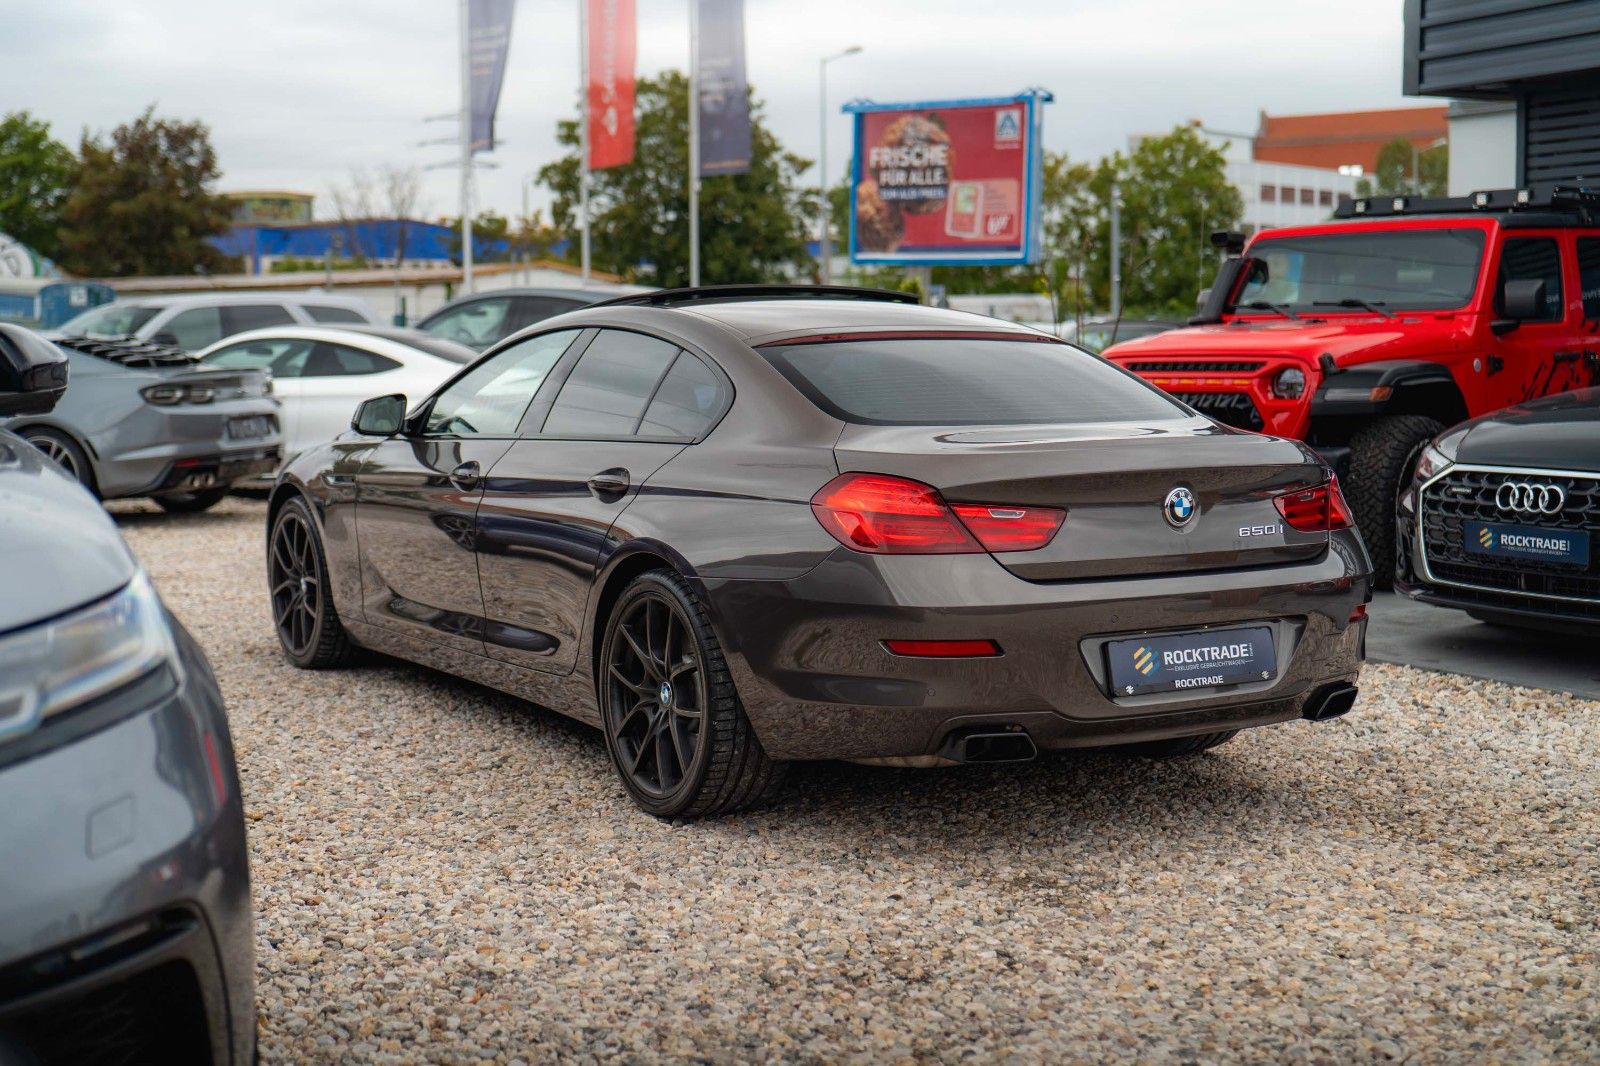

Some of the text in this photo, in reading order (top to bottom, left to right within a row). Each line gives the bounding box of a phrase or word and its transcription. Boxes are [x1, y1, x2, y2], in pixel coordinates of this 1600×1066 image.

[1500, 534, 1566, 551] ROCKTRADE
[1163, 643, 1249, 665] ROCKTRADE
[1174, 663, 1200, 672] EXKLUSIVE
[1175, 675, 1224, 688] ROCKTRADE
